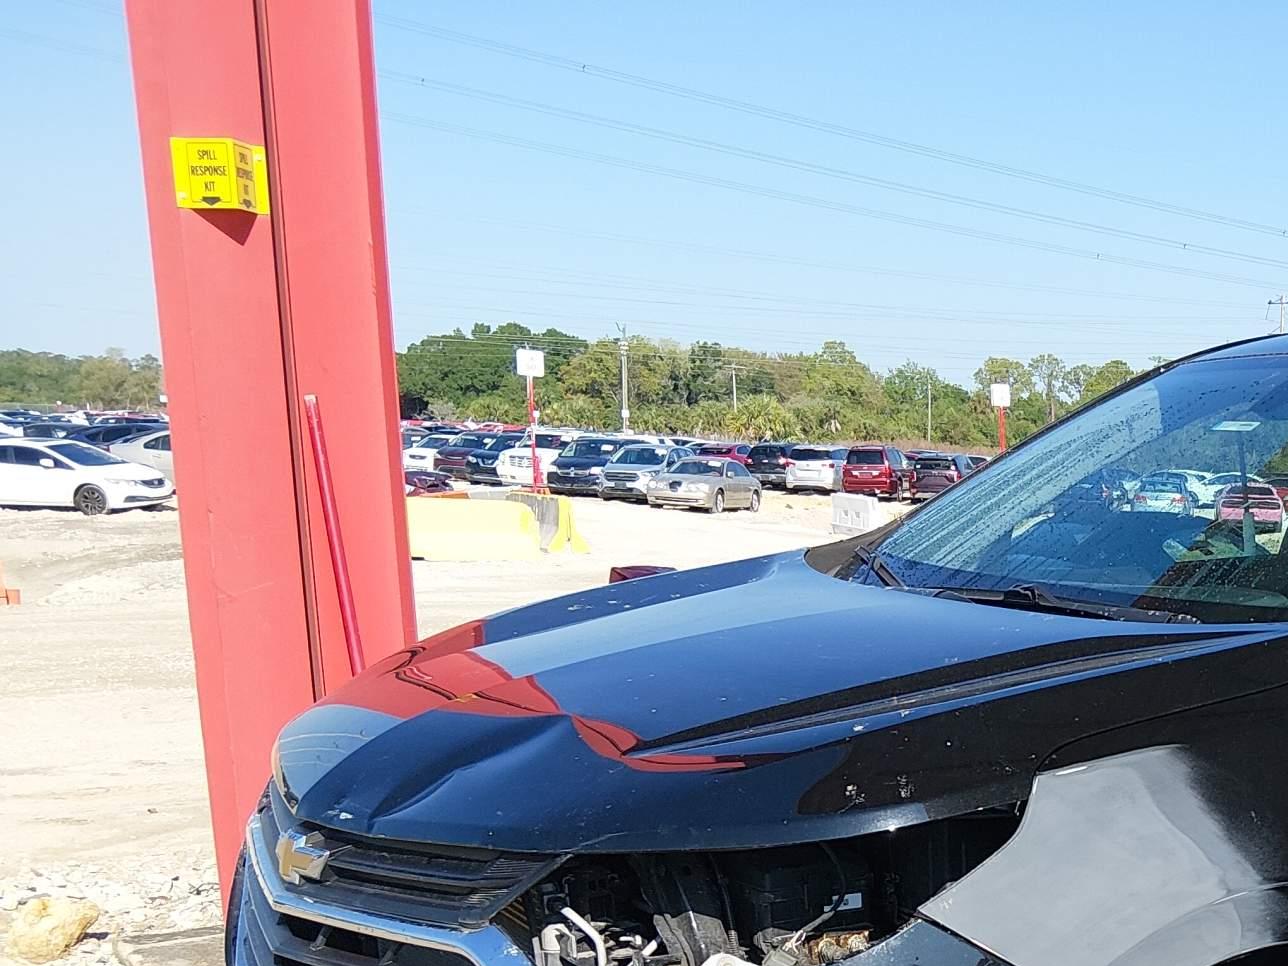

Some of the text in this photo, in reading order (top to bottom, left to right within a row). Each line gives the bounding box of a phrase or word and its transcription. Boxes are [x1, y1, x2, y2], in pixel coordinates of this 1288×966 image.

[197, 149, 217, 160] SPILL
[190, 165, 228, 176] RESPONSE
[204, 181, 215, 192] KIT
